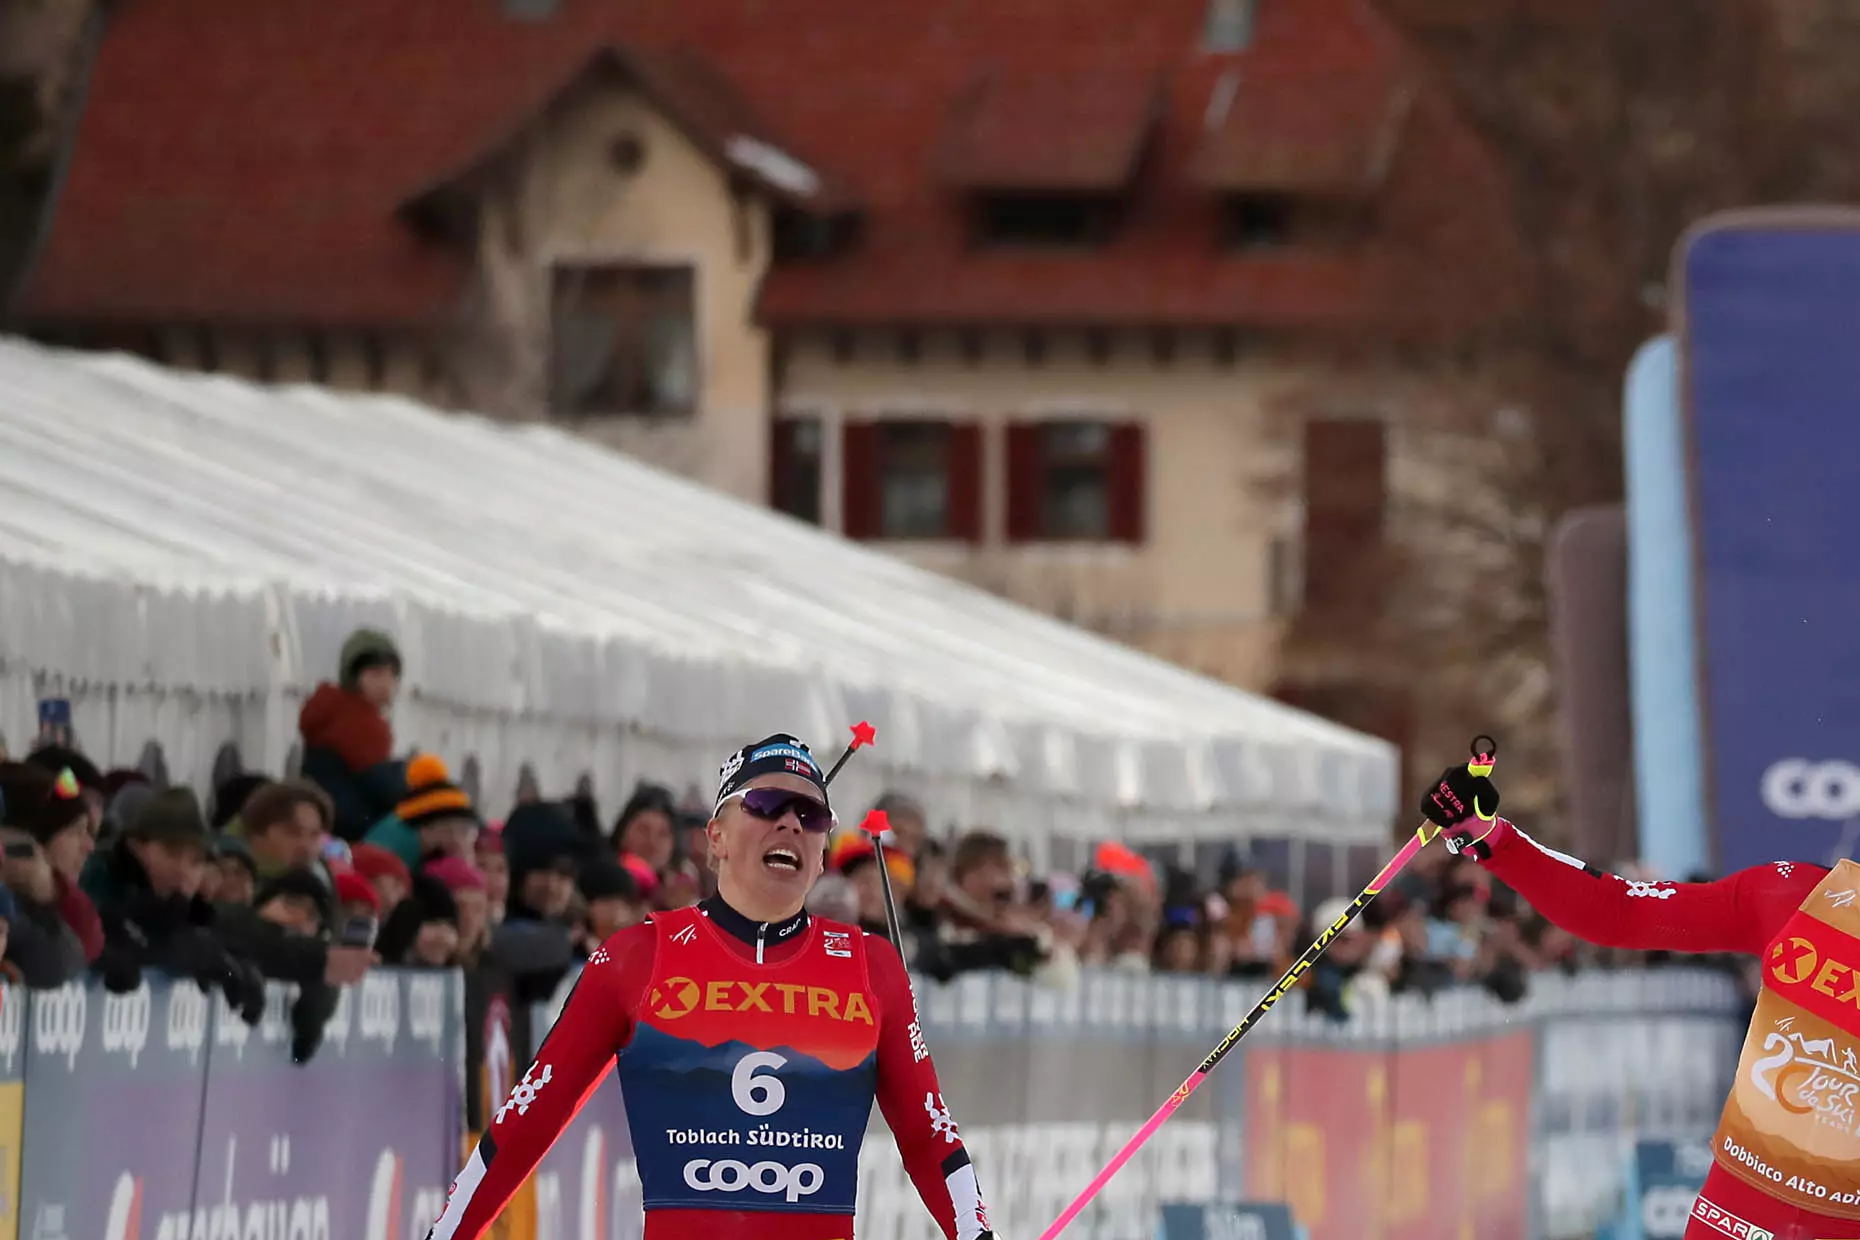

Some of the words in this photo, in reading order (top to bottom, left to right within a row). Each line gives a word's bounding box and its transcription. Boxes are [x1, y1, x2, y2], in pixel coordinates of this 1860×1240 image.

[704, 981, 874, 1026] EXTRA
[731, 1051, 788, 1116] 6
[666, 1128, 740, 1146] Toblach
[1723, 1135, 1783, 1184] Dobbiaco
[683, 1158, 825, 1203] coop
[1695, 1201, 1750, 1240] SPAR
